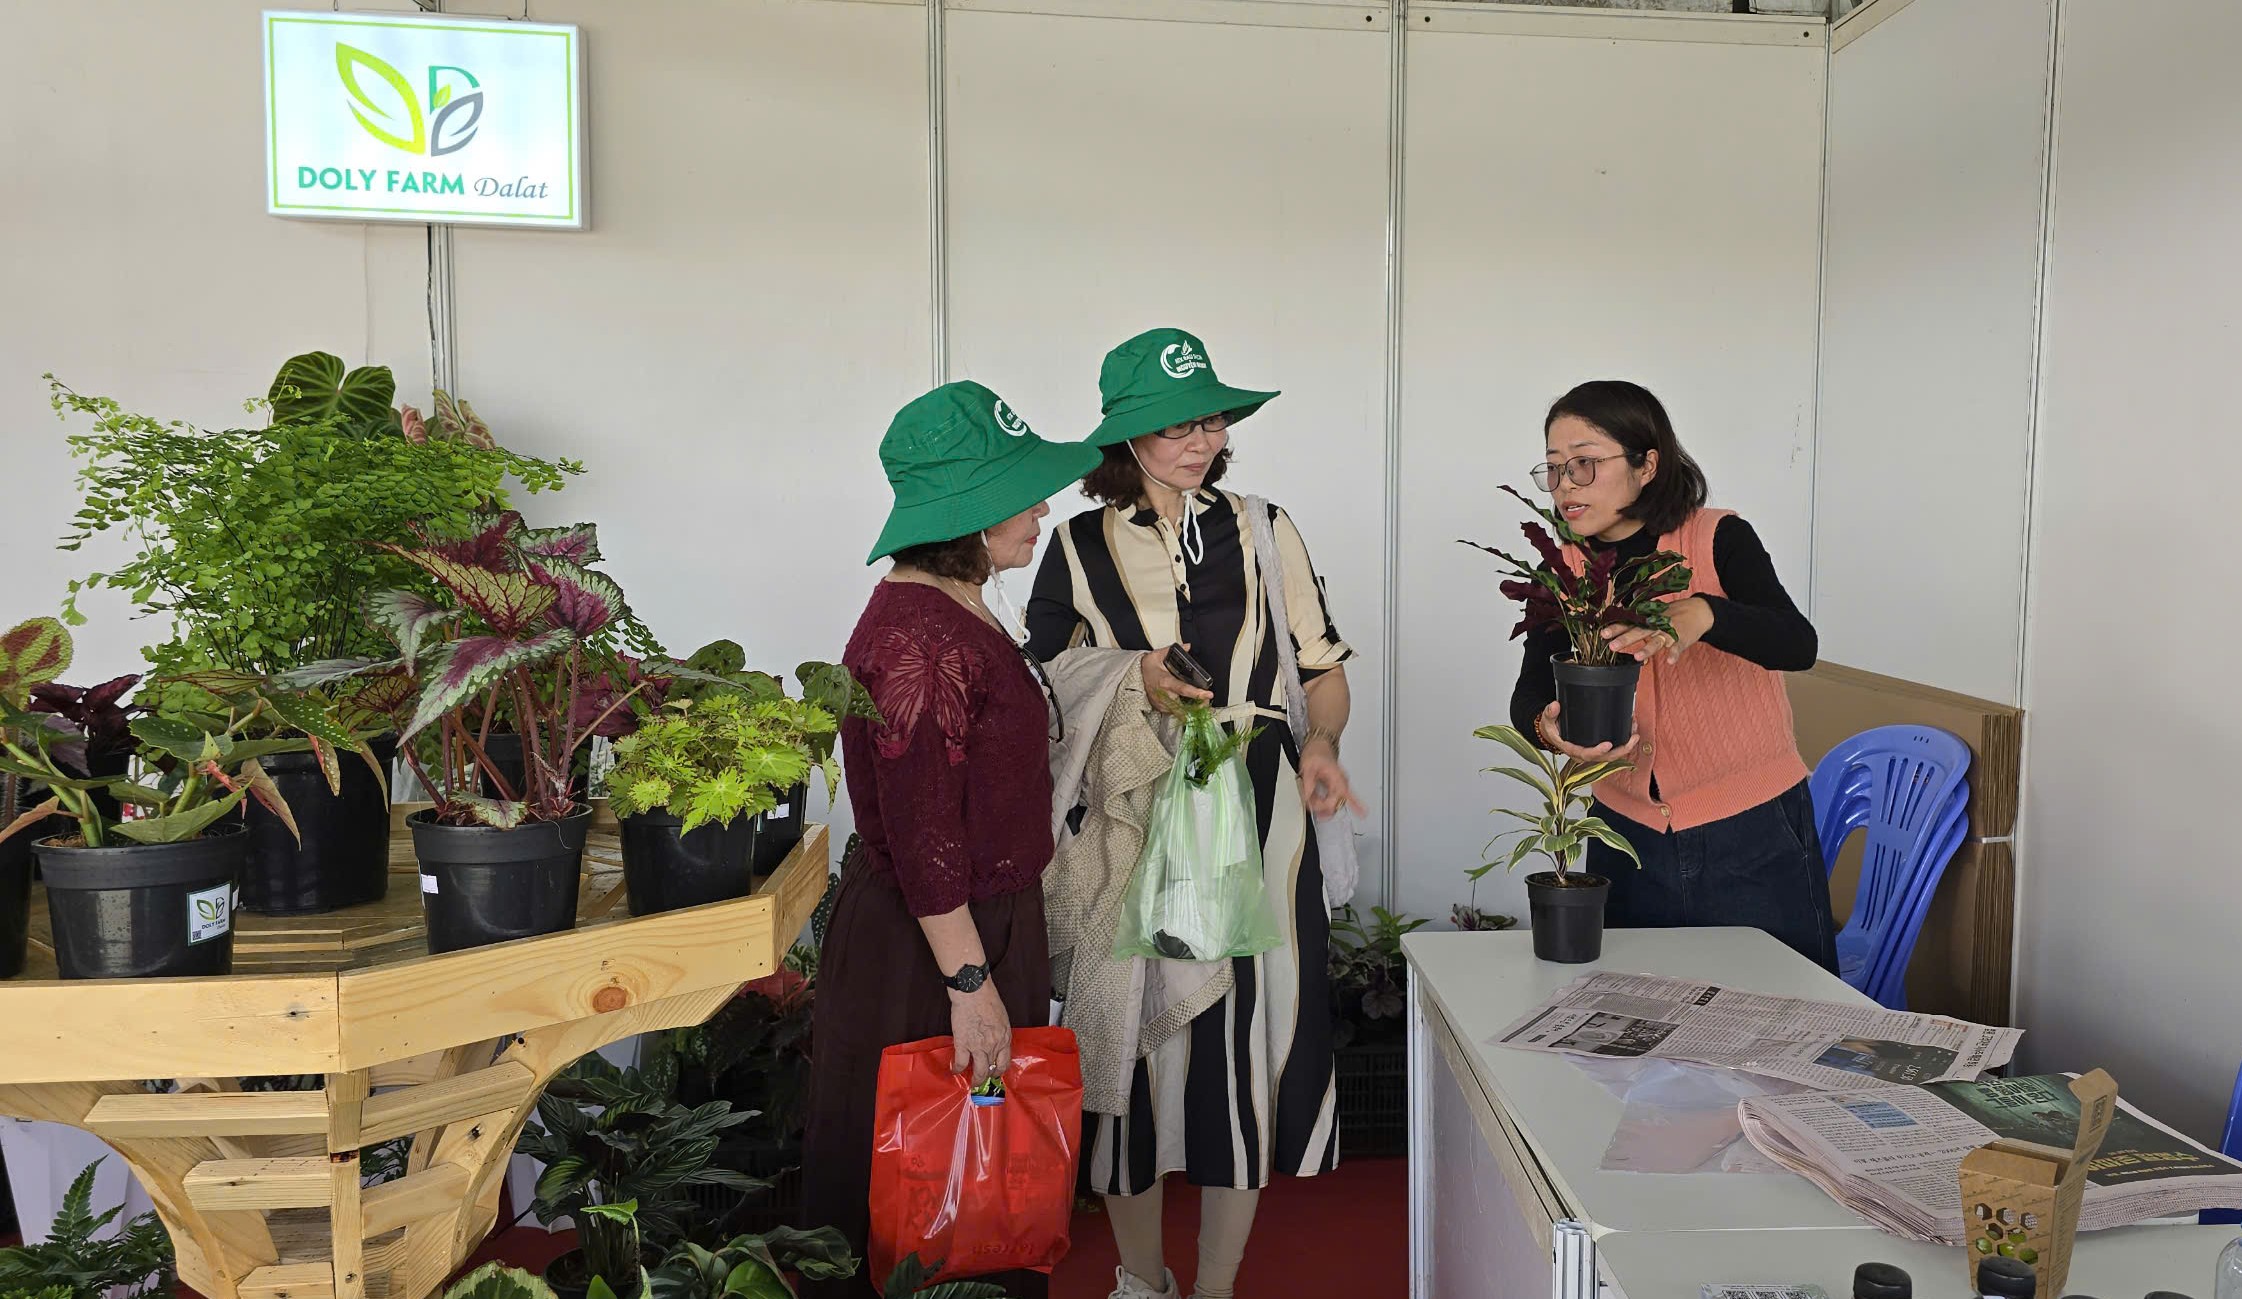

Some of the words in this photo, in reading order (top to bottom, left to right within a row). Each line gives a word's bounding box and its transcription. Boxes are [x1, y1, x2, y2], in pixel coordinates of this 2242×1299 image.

[298, 166, 377, 191] DOLY
[387, 170, 465, 195] FARM
[473, 176, 549, 199] Dalat
